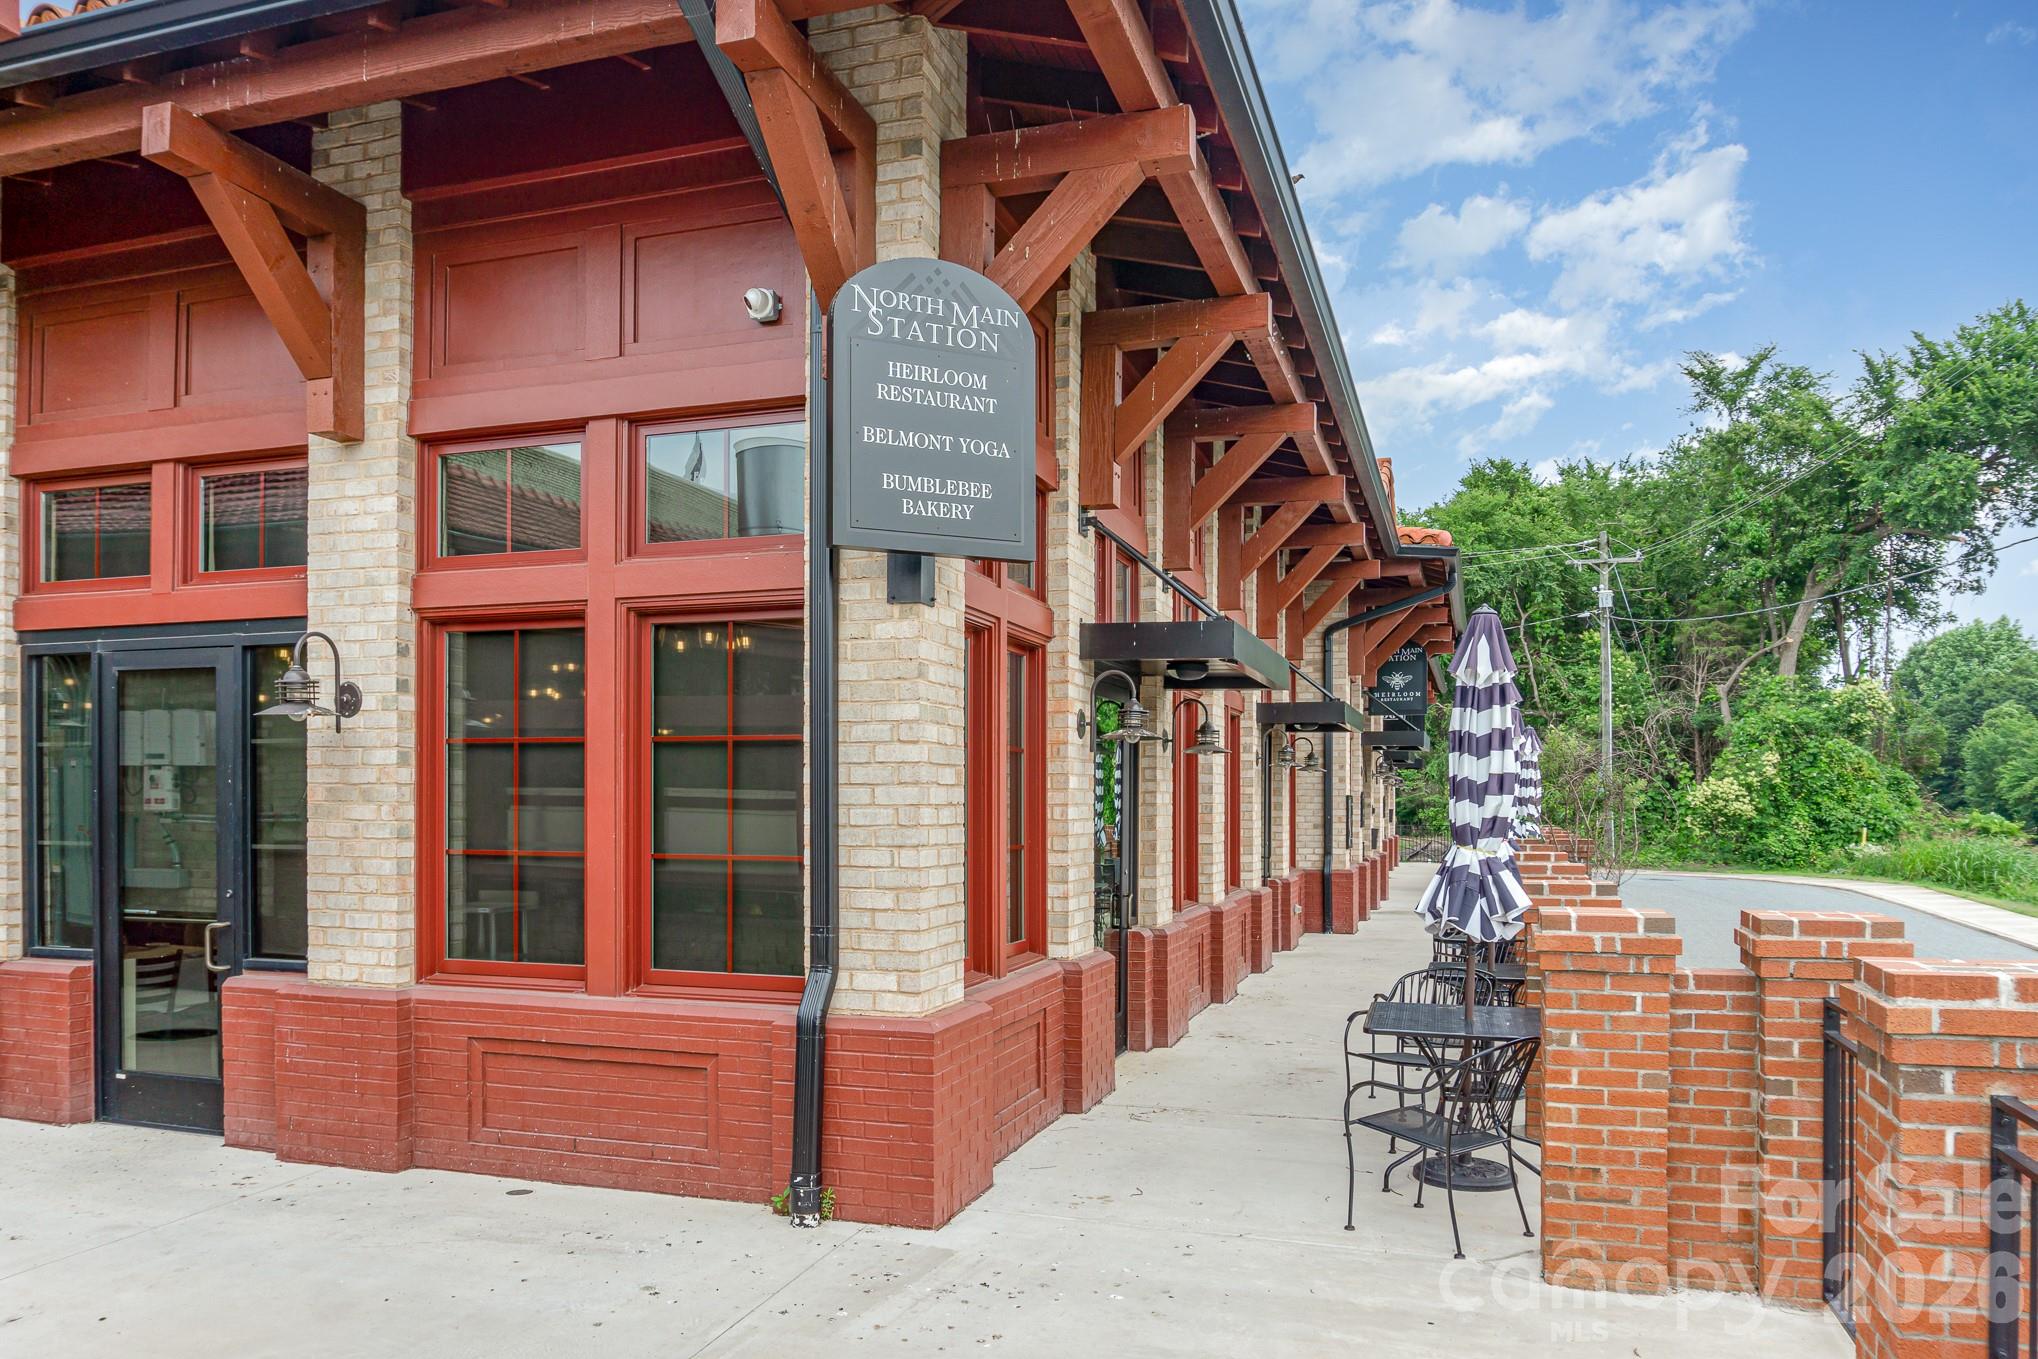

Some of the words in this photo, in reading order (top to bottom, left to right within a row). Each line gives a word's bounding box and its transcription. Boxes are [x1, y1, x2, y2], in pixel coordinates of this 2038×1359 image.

[851, 284, 945, 317] NORTH
[951, 301, 1020, 329] MAIN
[867, 307, 1000, 353] STATION
[887, 361, 988, 390] HEIRLOOM
[876, 383, 998, 414] RESTAURANT
[862, 426, 954, 452] BELMONT
[959, 437, 1011, 459] YOGA
[881, 472, 993, 499] BUMBLEBEE
[902, 498, 975, 521] BAKERY
[1389, 654, 1416, 662] ATION
[1402, 647, 1422, 656] MAIN
